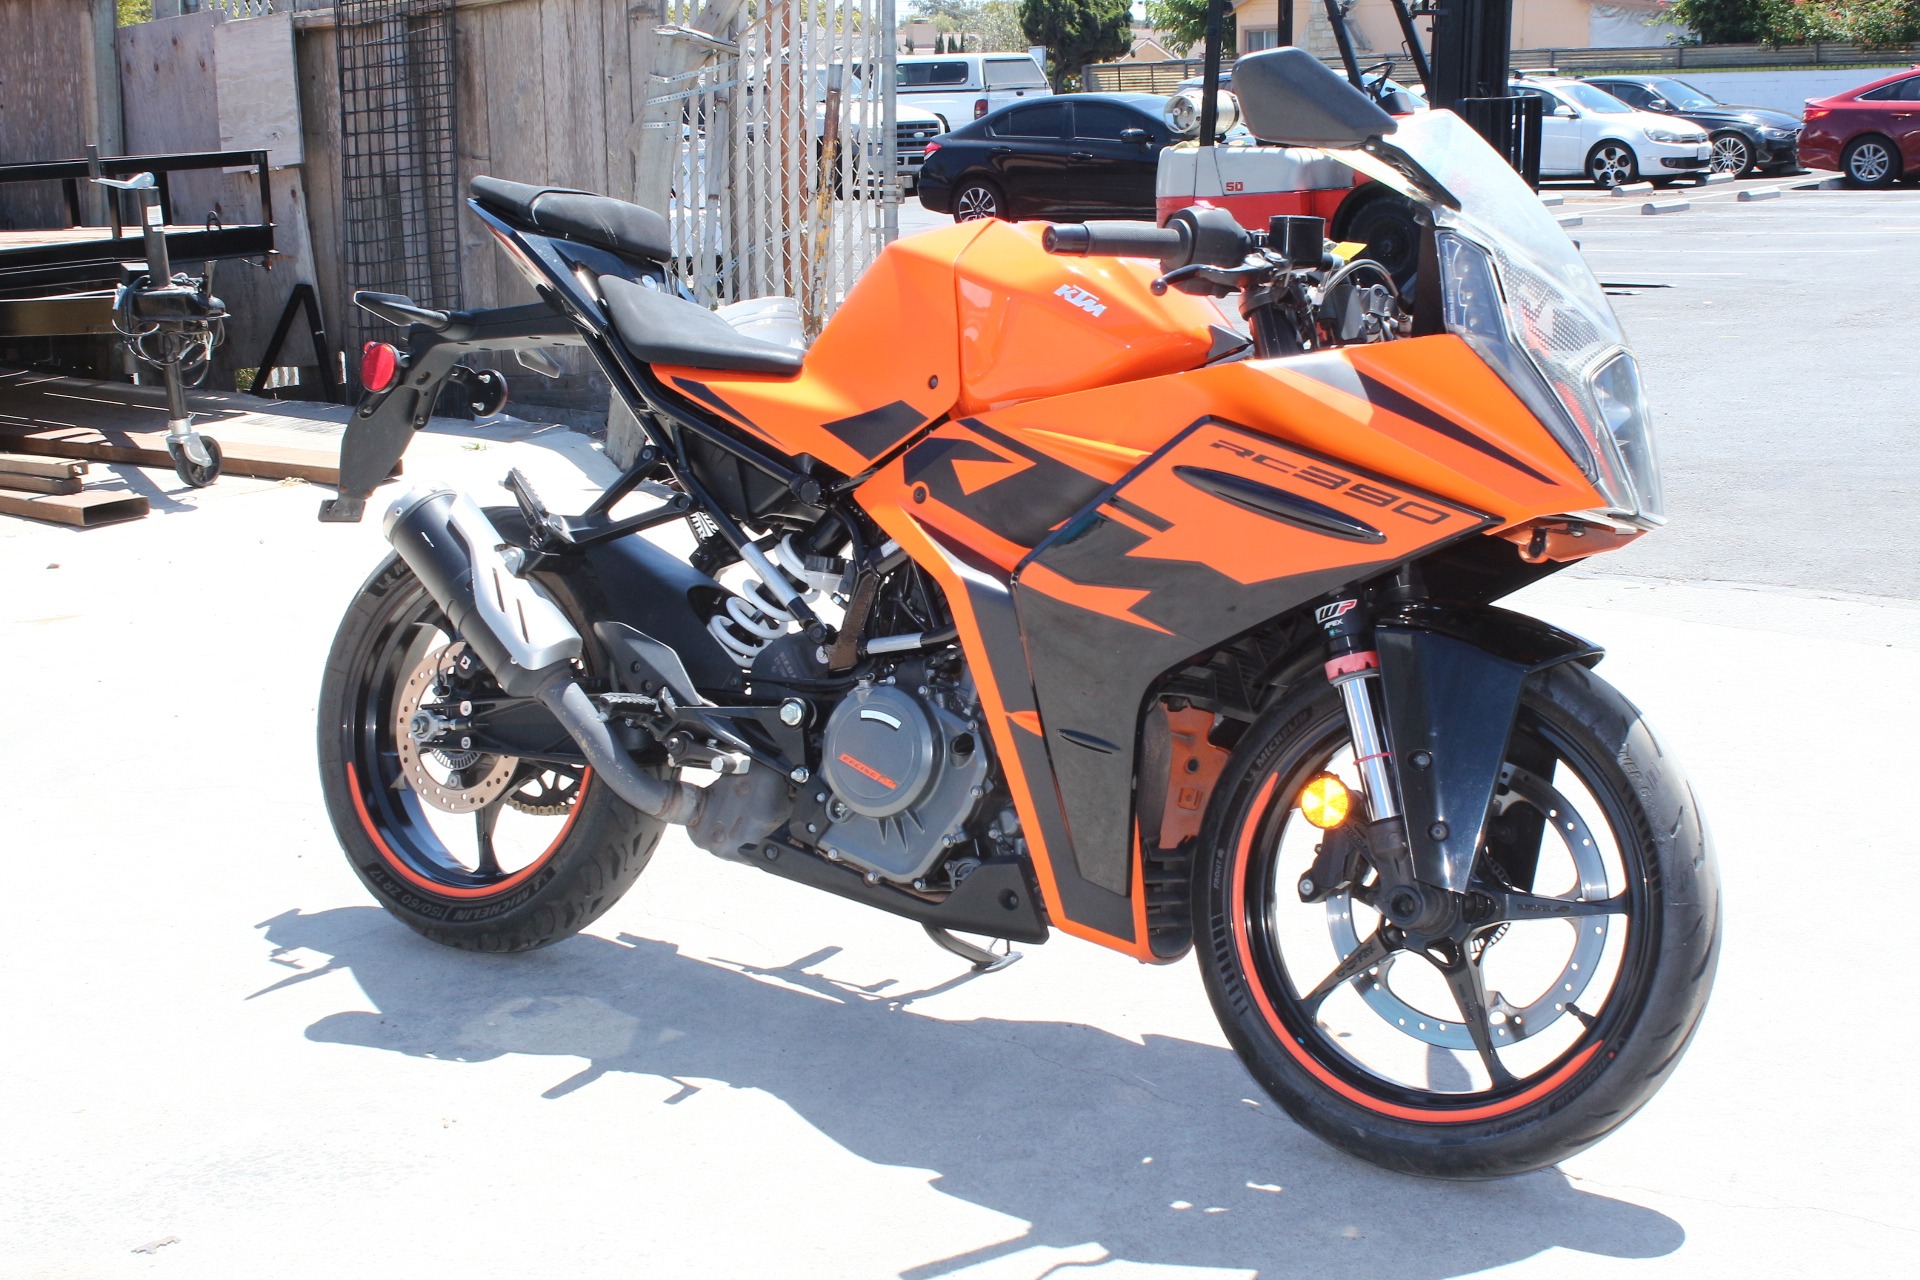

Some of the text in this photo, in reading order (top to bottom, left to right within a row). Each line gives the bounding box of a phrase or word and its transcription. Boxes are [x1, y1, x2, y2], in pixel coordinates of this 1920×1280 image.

[1053, 283, 1108, 318] KTM
[1255, 708, 1310, 768] MICHELIN
[1213, 860, 1223, 889] FRONT
[453, 888, 530, 921] MICHELIN
